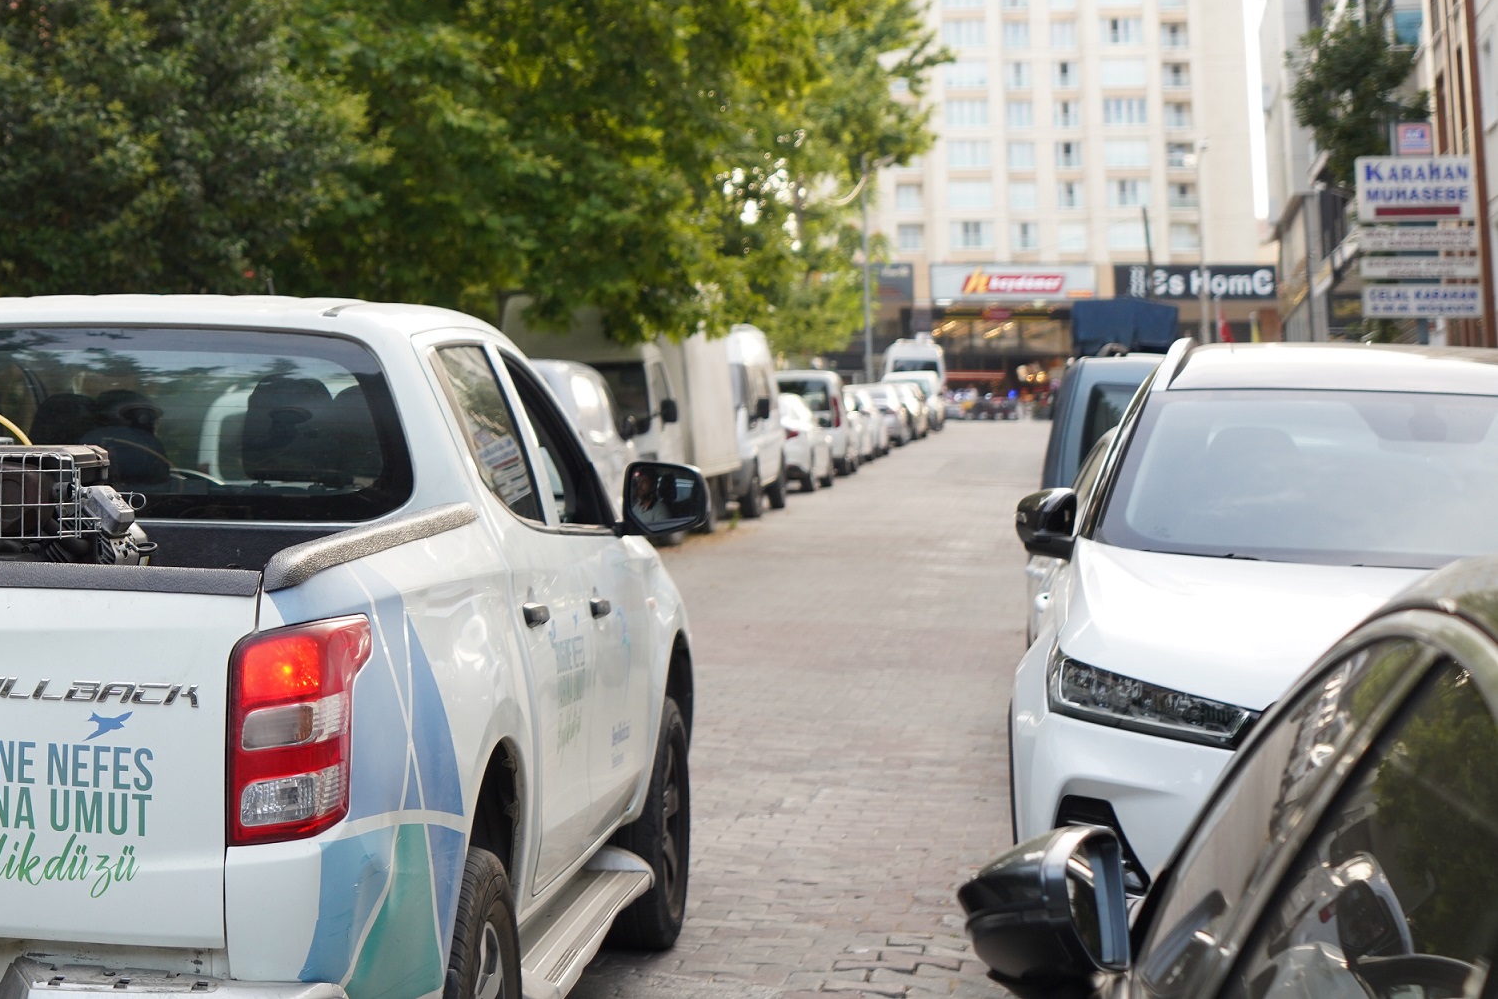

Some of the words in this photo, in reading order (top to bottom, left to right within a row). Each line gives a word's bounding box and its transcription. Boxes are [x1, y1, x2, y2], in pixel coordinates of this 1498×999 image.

[1365, 161, 1468, 182] KARAHAN
[1365, 186, 1469, 201] MUHASEBE
[47, 742, 154, 792] NEFES
[50, 788, 153, 837] UMUT
